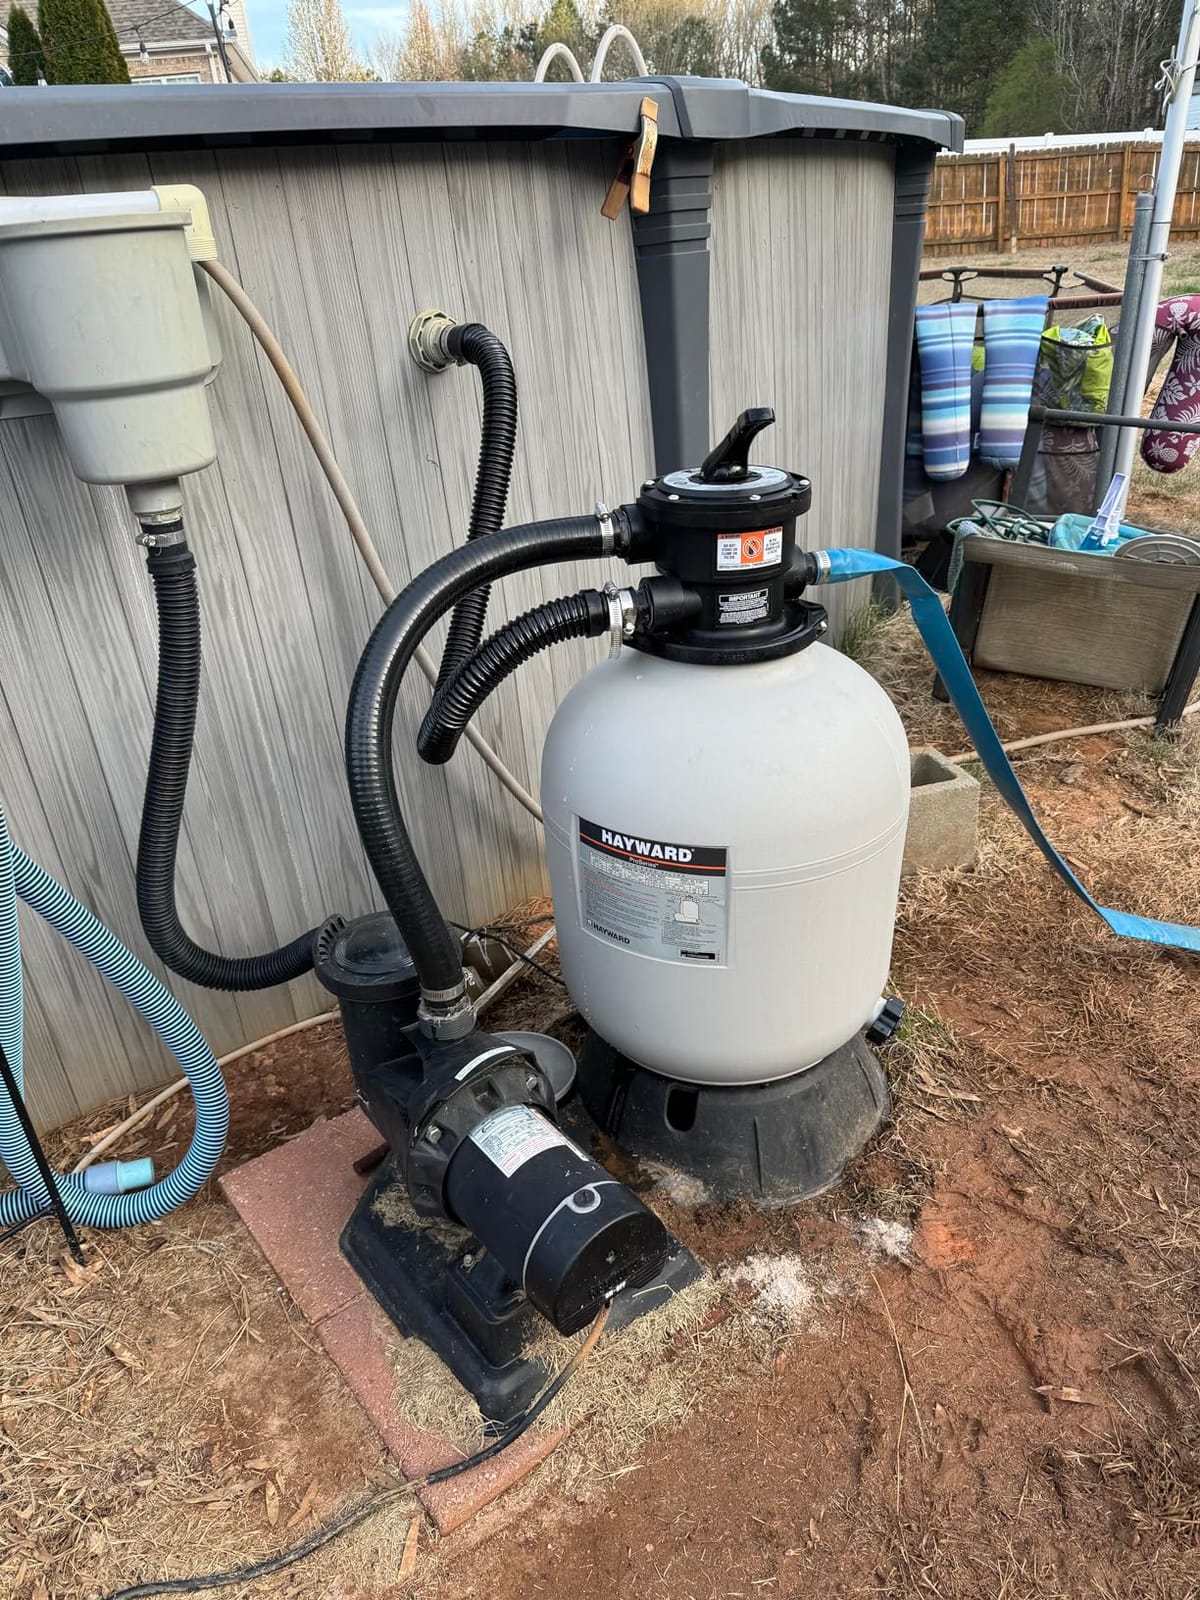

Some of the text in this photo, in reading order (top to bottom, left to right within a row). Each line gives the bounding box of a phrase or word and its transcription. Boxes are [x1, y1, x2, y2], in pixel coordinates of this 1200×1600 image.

[728, 592, 761, 602] IMPORTANT
[601, 829, 693, 863] HAYWARD
[593, 922, 631, 945] HAYWARD
